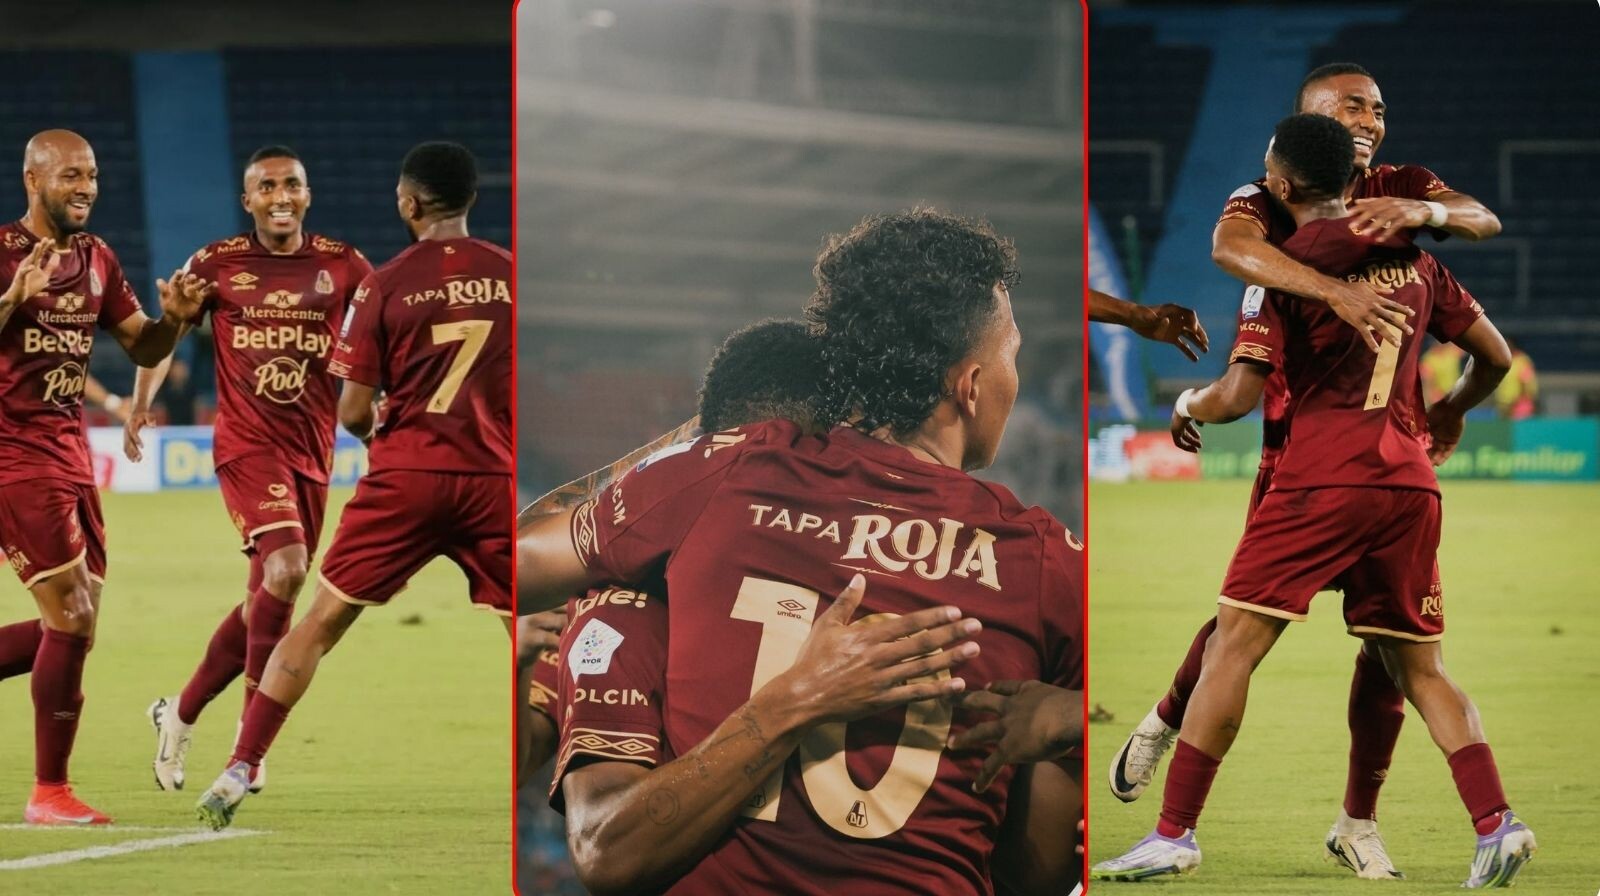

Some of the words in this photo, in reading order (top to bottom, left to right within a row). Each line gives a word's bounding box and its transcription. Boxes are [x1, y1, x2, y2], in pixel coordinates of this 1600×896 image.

[403, 289, 446, 306] TAPA
[446, 278, 512, 306] ROJA
[37, 309, 98, 323] Mercacentr
[242, 306, 326, 321] Mercacentro
[24, 328, 93, 357] BetPla
[232, 326, 331, 358] BetPlay
[43, 362, 87, 402] Pool
[254, 358, 309, 396] Pool
[425, 319, 495, 415] 7
[749, 503, 842, 544] TAPA
[840, 513, 1002, 592] ROJA
[776, 610, 803, 621] umbro
